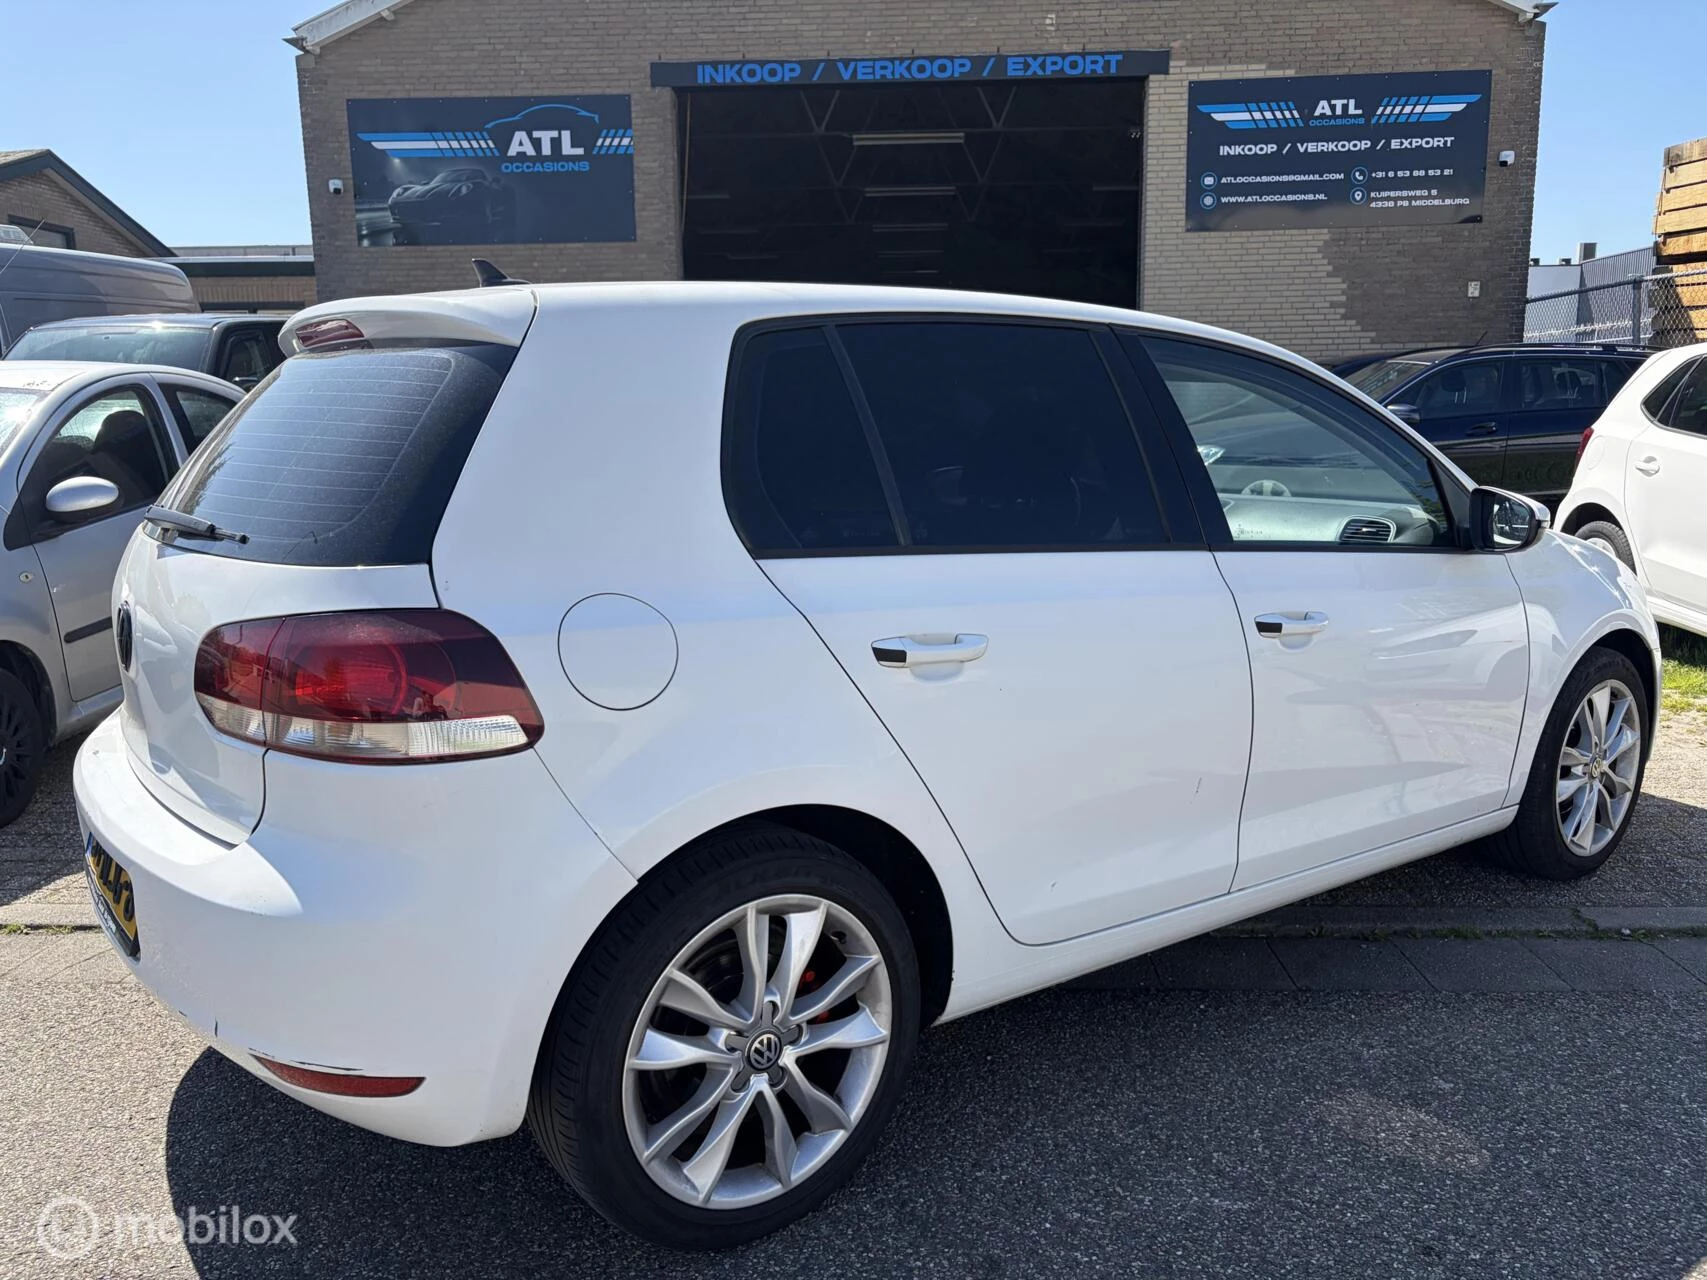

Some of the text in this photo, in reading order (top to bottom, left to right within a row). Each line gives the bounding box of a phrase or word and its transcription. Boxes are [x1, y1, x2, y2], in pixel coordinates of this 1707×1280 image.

[697, 63, 801, 83] INKOOP
[837, 58, 972, 80] VERKOOP
[1007, 54, 1123, 76] EXPORT
[1314, 99, 1362, 116] ATL
[1309, 117, 1365, 127] OCCASIONS
[507, 130, 584, 156] ATL
[1220, 144, 1277, 155] INKOOP
[1297, 141, 1371, 152] VERKOOP
[1391, 137, 1454, 149] EXPORT
[501, 161, 590, 173] OCCASIONS
[1387, 170, 1395, 178] 6
[1220, 193, 1328, 204] WWW.ATLOCCASIONS.NL
[1370, 189, 1429, 199] KUIPERSWEG
[1411, 197, 1470, 207] MIDDELBURG
